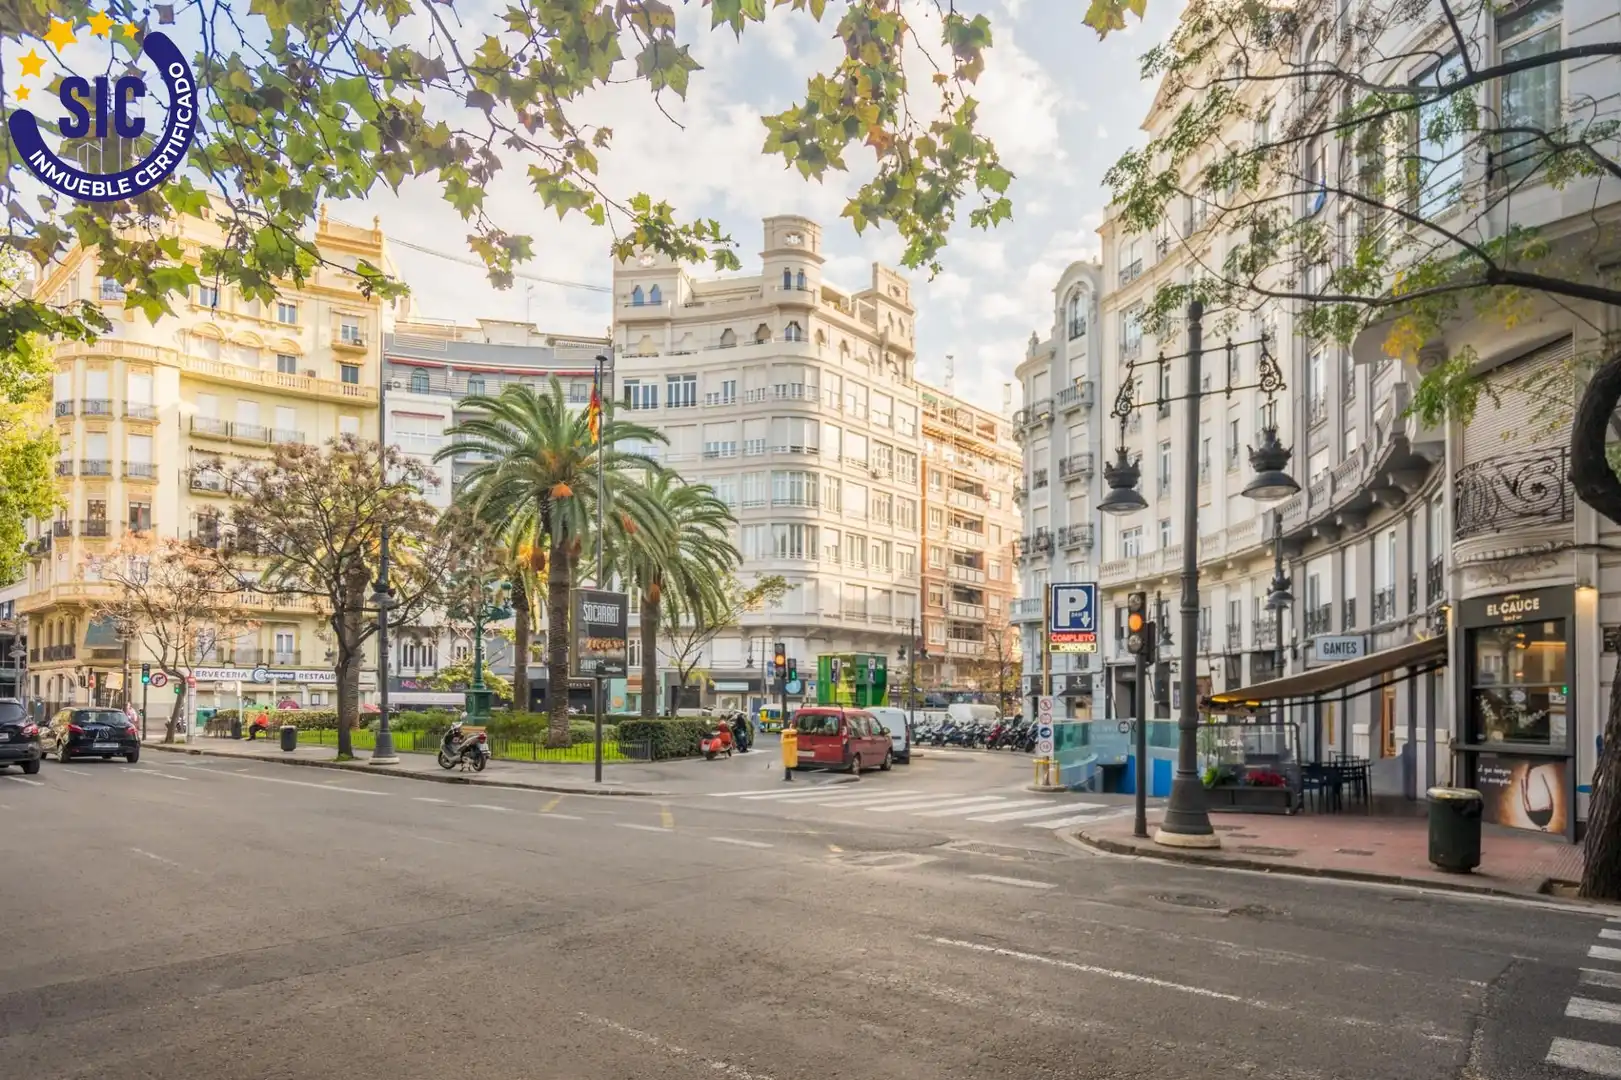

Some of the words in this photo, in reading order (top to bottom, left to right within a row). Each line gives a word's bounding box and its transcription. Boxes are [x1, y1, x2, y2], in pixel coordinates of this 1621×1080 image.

[583, 603, 620, 624] SOCARRAT
[1057, 588, 1088, 627] P
[1500, 597, 1540, 615] CAUCE
[1051, 632, 1096, 643] COMPLETO
[1323, 640, 1357, 655] GANTES
[195, 670, 248, 679] ERVECERIA
[299, 673, 336, 681] RESTAUR
